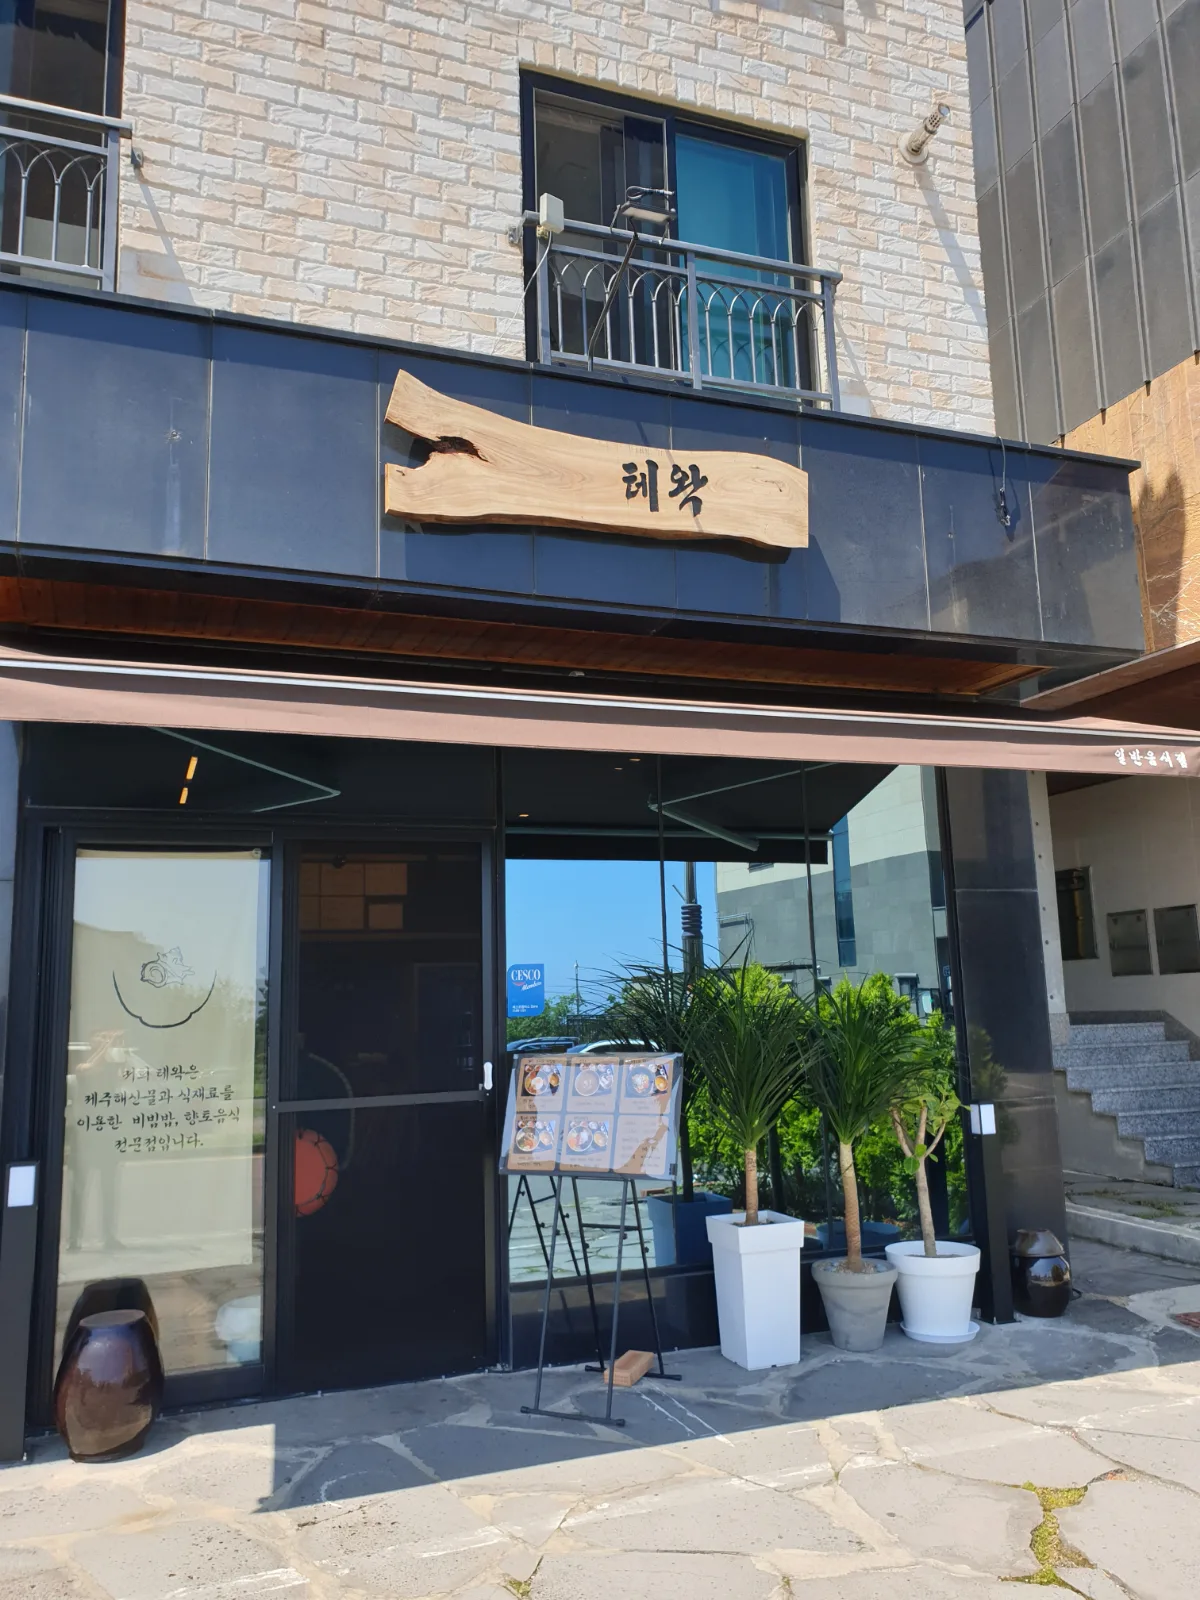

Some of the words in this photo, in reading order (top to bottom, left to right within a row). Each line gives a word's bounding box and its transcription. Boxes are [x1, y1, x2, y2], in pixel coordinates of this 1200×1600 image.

[621, 459, 709, 518] 테왁
[511, 969, 541, 981] CESCO
[84, 1089, 173, 1107] 제주해산물과
[178, 1084, 234, 1103] 식재료를
[77, 1114, 122, 1132] 이용한
[132, 1111, 178, 1129] 비빔밥,
[183, 1106, 240, 1126] 향토음식
[114, 1132, 204, 1153] 전문점입니다.
